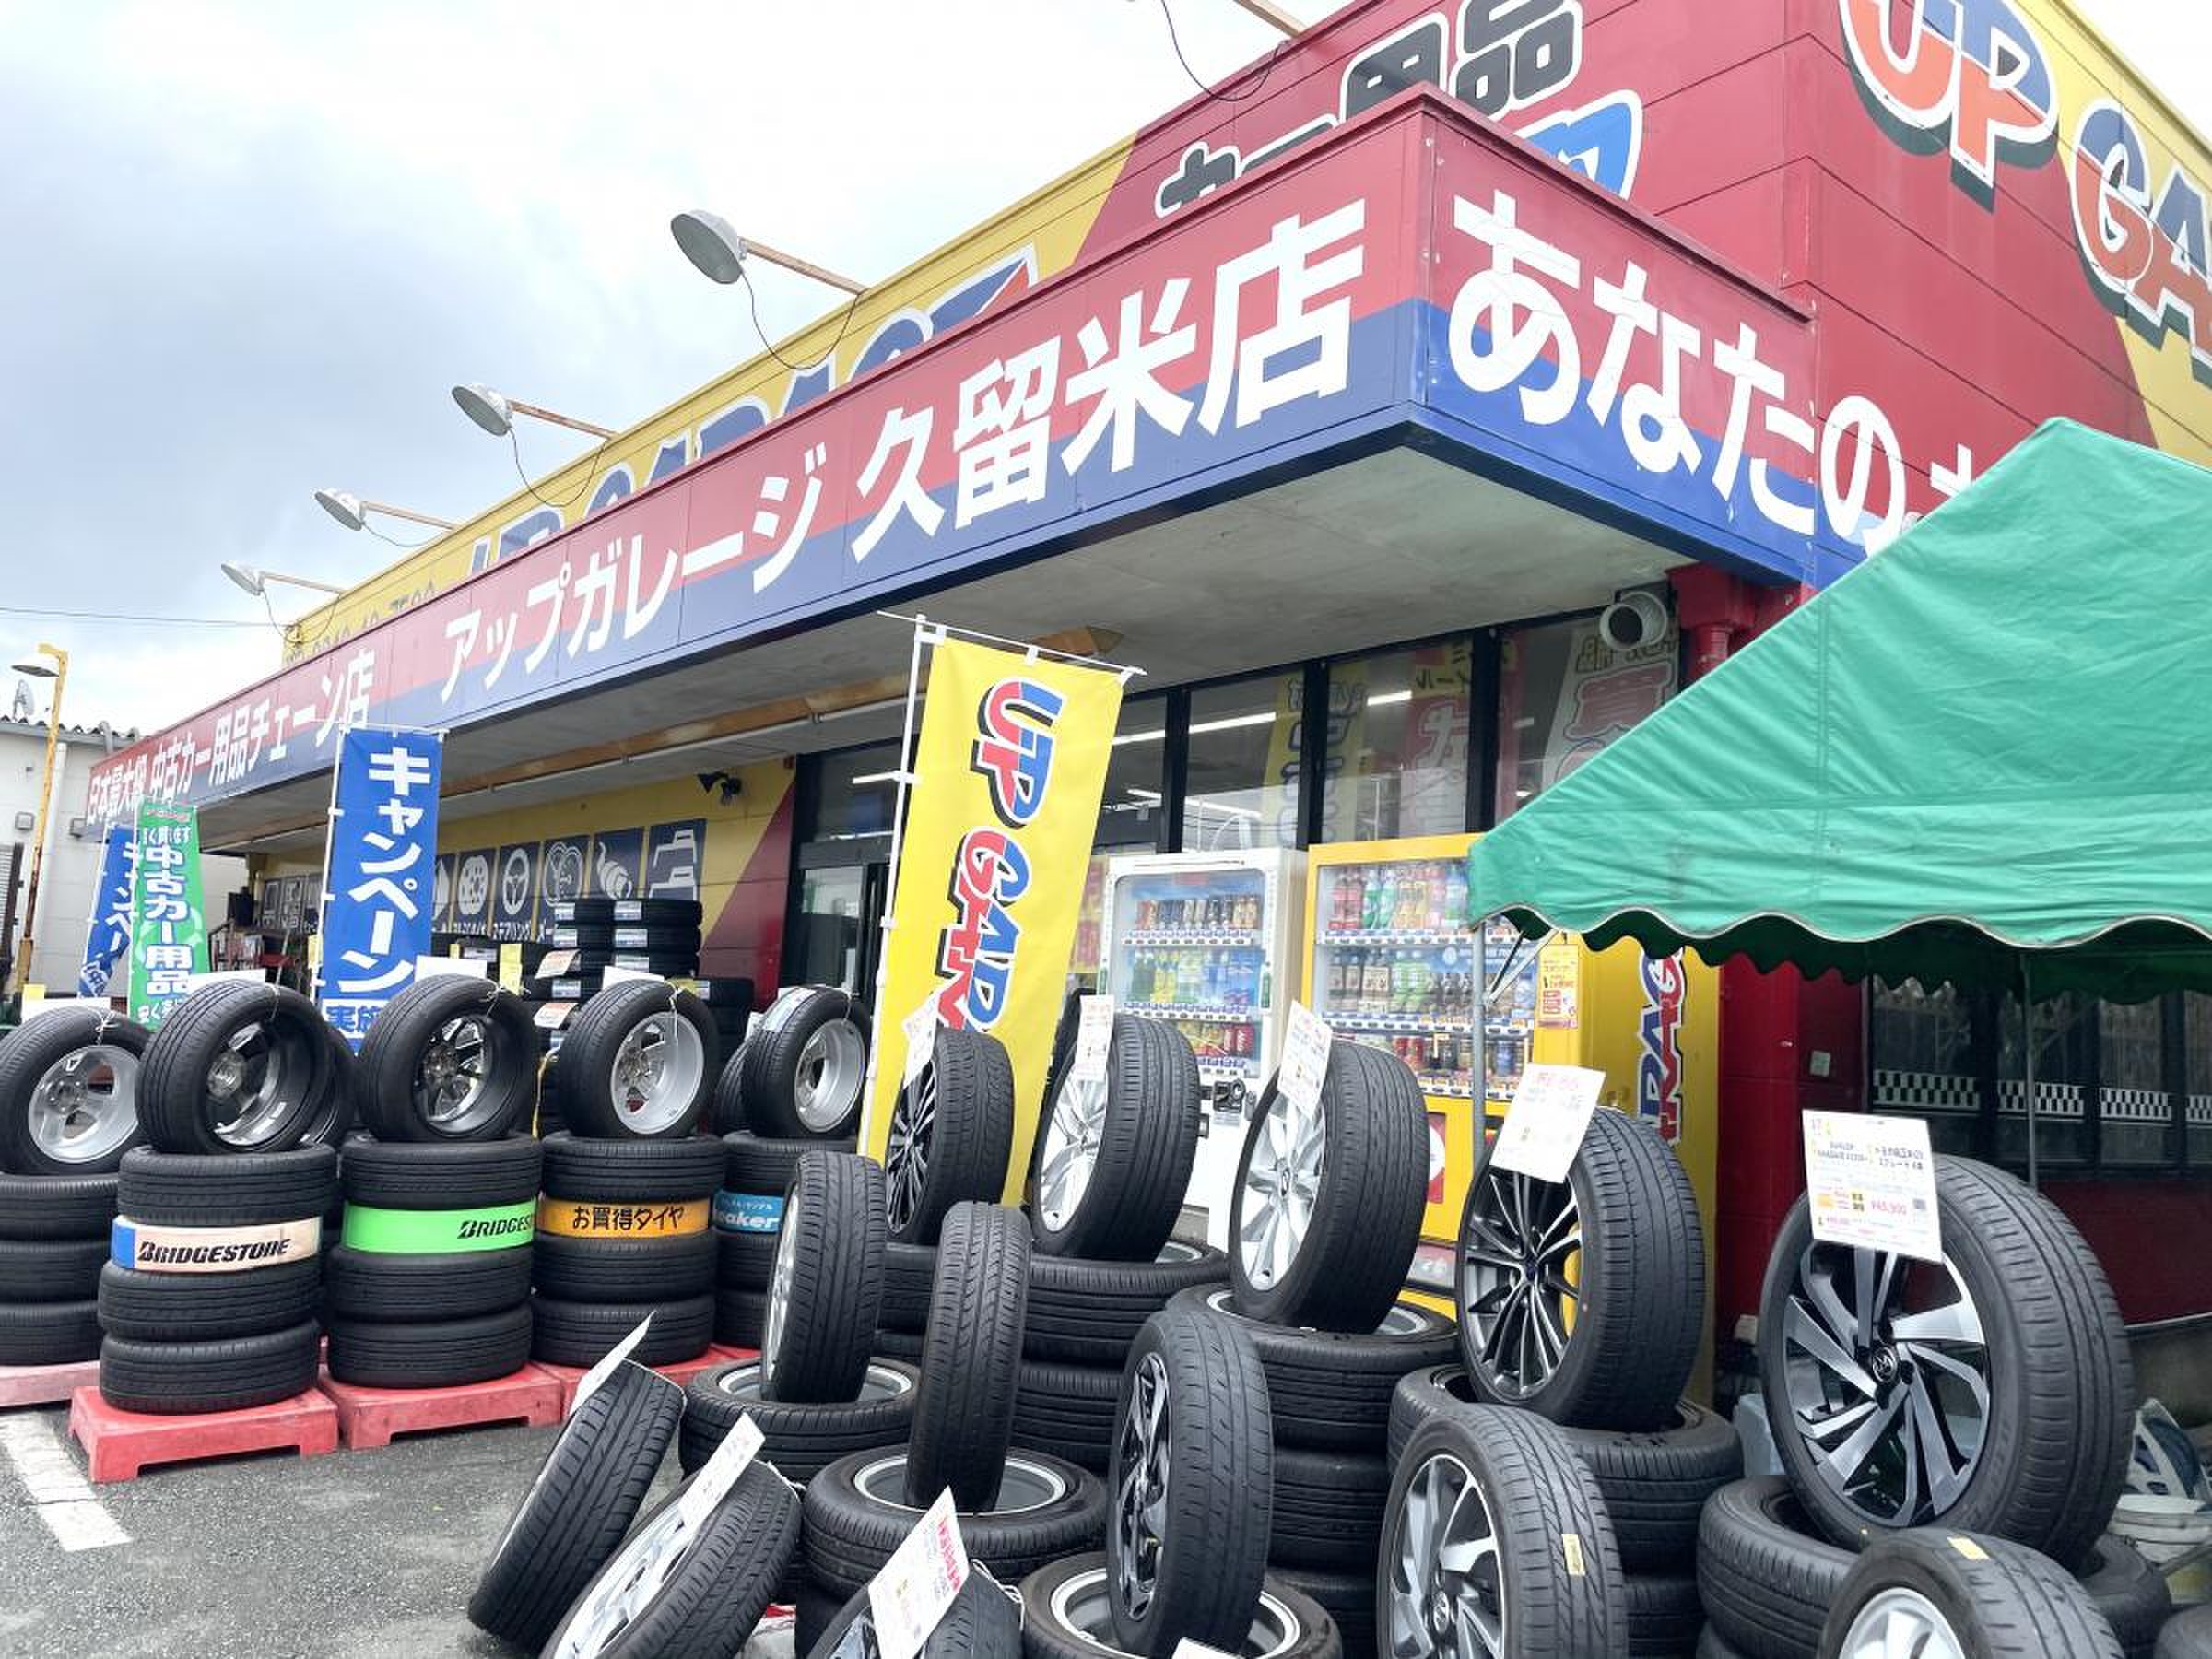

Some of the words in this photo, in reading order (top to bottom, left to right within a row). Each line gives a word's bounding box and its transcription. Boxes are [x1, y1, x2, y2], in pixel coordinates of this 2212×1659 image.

[1841, 0, 2060, 212] UP
[149, 648, 375, 804] 中古カー用品チェーン店
[440, 441, 829, 704] アップガレージ
[850, 196, 1365, 561] 久留米店
[971, 676, 1067, 828] UP
[143, 843, 194, 996] 中古カー用品
[337, 747, 430, 993] キャンペーン
[137, 1238, 291, 1264] BRIDGESTONE
[572, 1206, 685, 1230] お買得タイヤ
